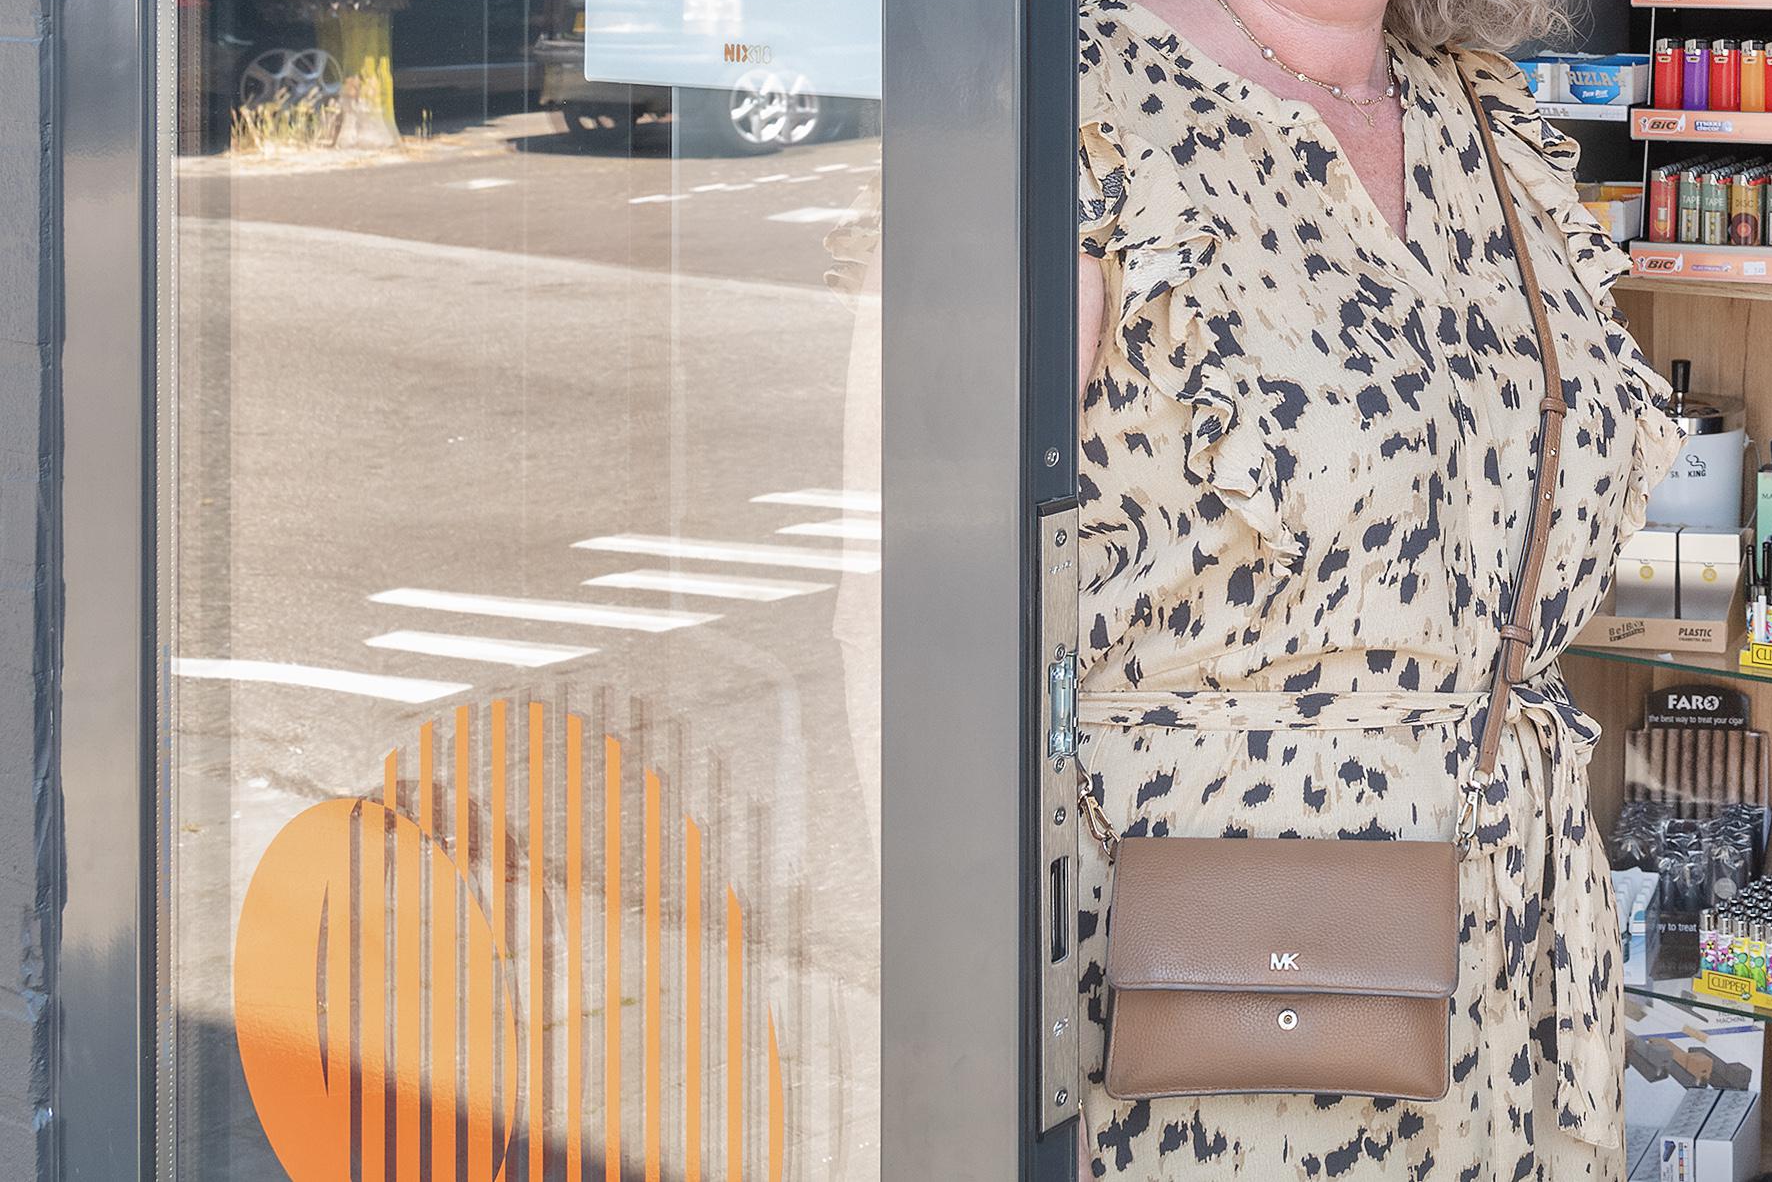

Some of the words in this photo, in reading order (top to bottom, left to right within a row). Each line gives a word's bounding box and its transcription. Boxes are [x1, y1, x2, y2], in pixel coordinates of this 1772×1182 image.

[724, 44, 772, 64] NIX18
[1679, 628, 1712, 637] PLASTIC
[1668, 695, 1719, 710] FARO
[1270, 952, 1299, 971] MK
[1712, 976, 1746, 993] CLIPPER
